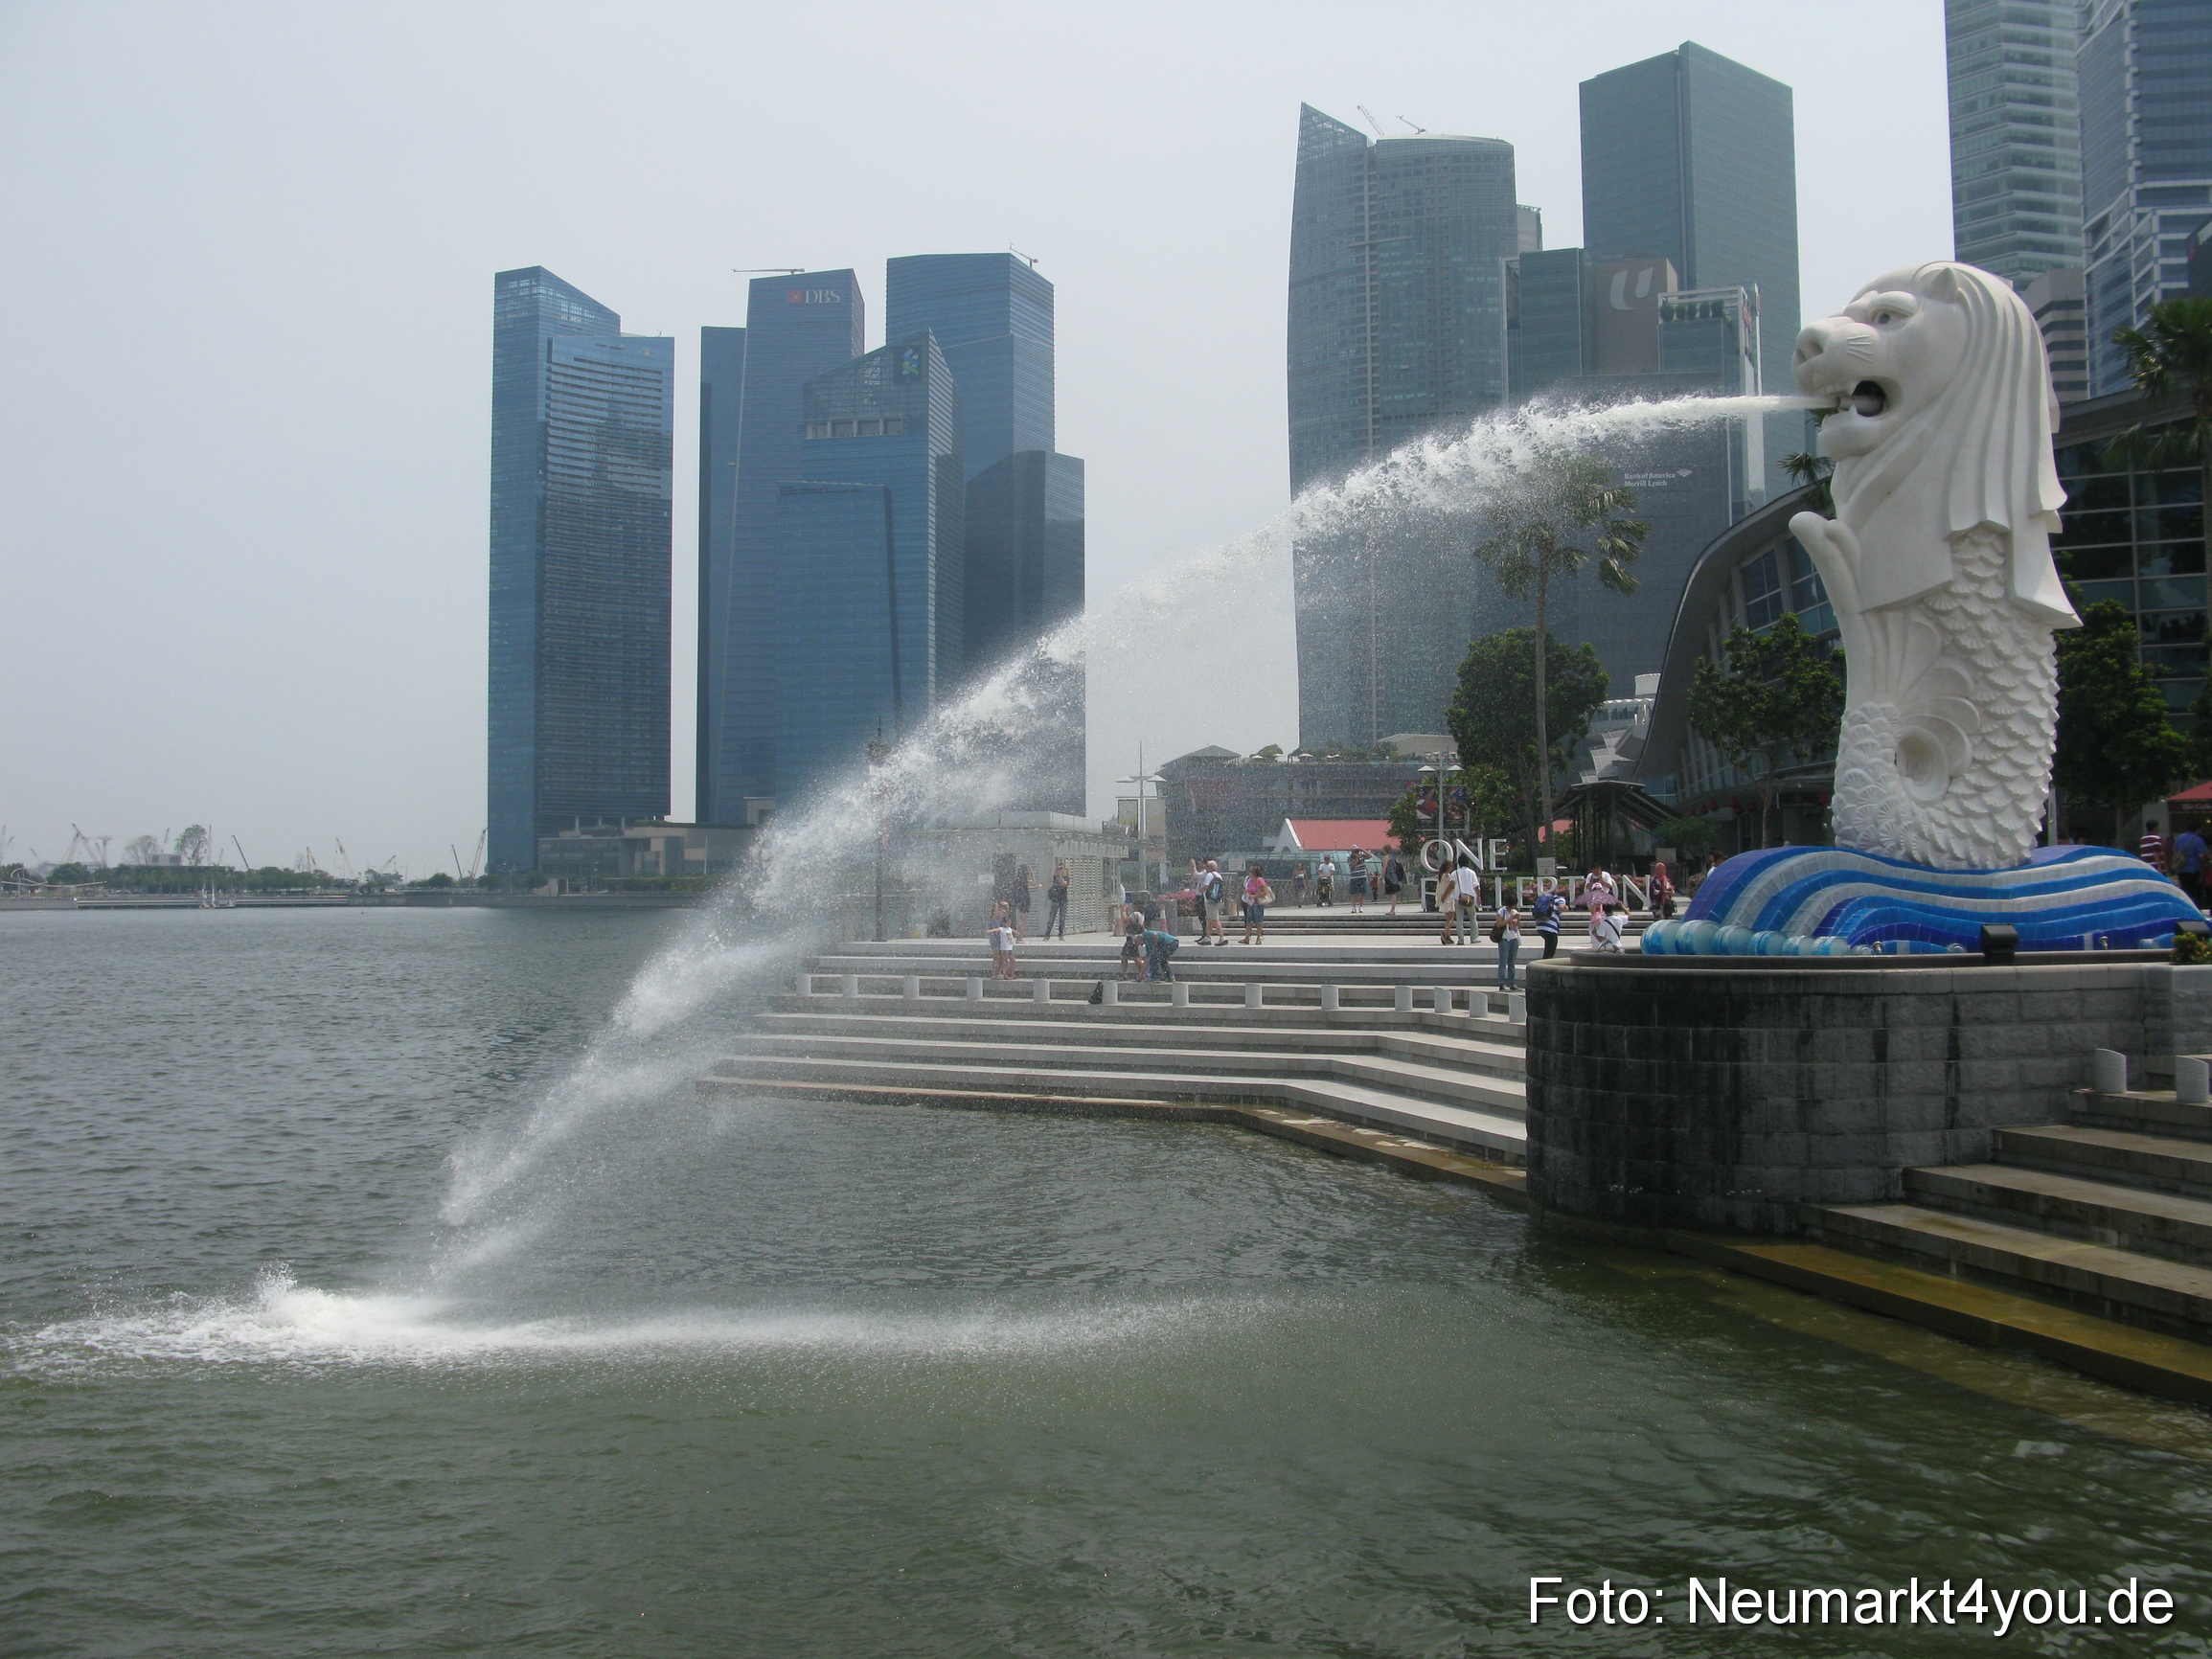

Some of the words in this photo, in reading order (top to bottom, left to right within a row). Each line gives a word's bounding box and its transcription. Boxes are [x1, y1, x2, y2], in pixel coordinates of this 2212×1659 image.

[806, 289, 841, 304] DBS
[1648, 471, 1676, 480] America
[1420, 838, 1508, 873] ONE
